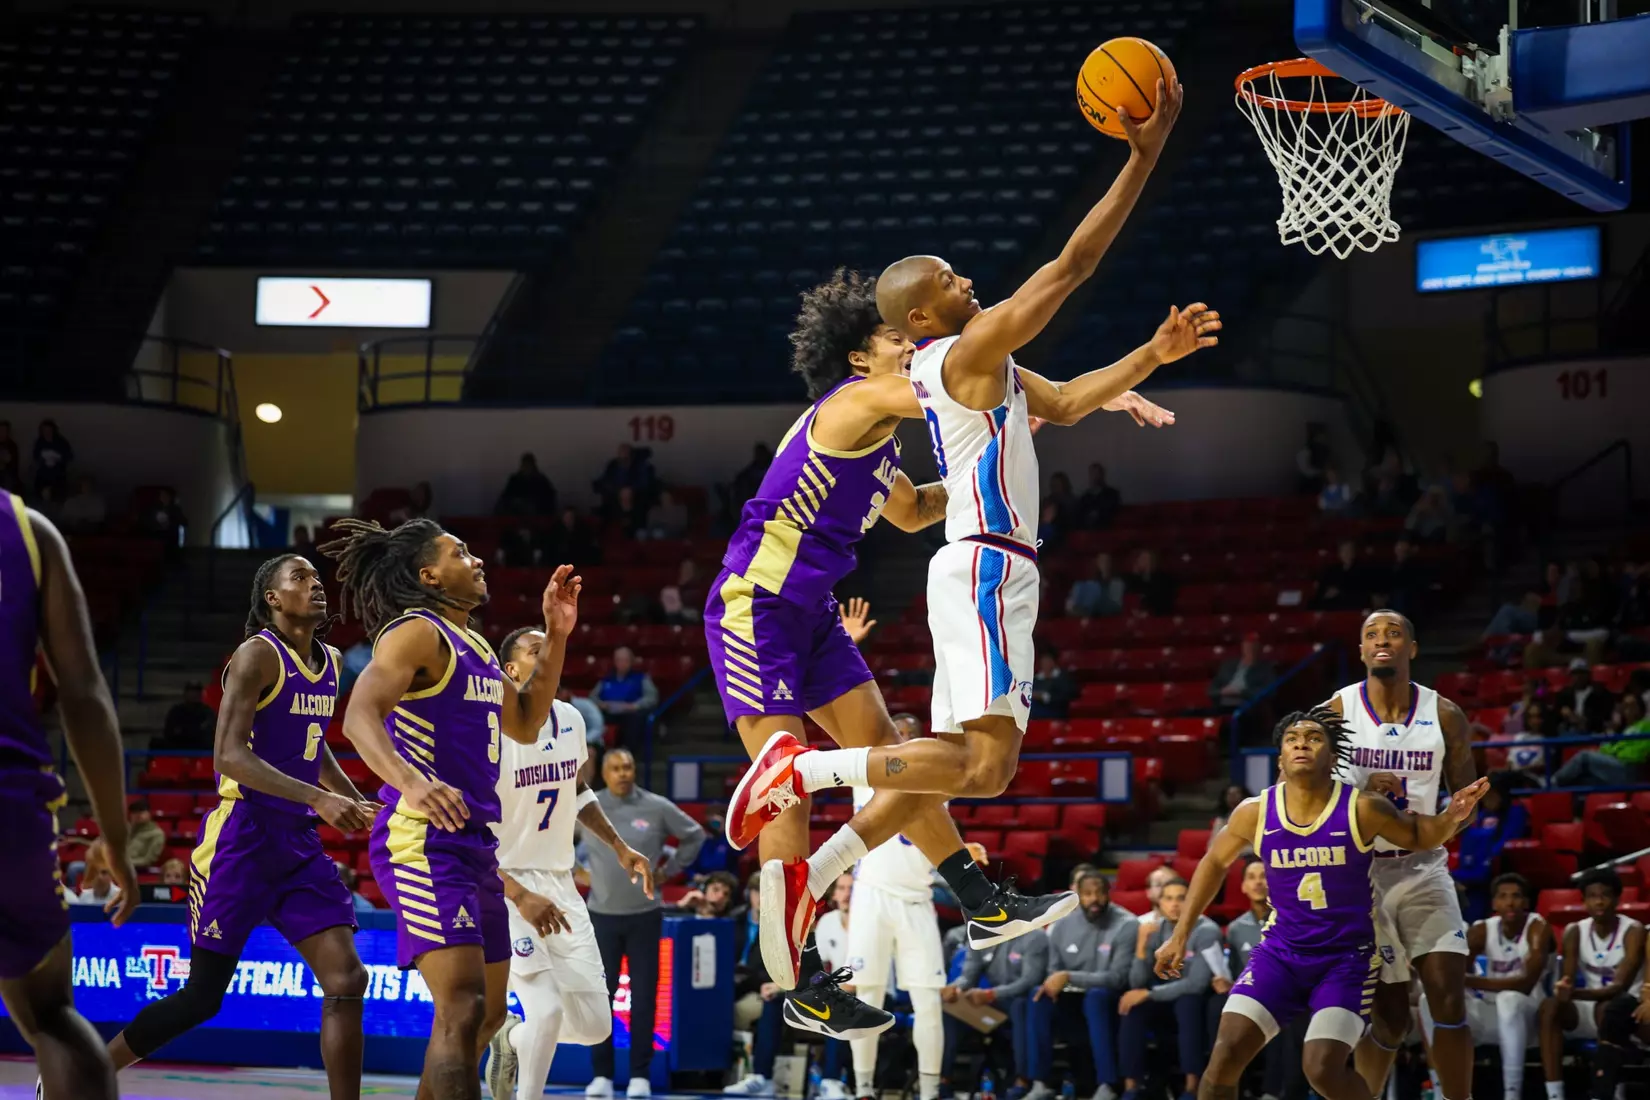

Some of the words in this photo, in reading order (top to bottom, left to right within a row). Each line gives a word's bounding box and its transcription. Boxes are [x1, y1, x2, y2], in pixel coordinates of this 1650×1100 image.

[1556, 368, 1607, 400] 101
[628, 415, 674, 442] 119
[463, 674, 504, 706] ALCOR
[487, 711, 500, 764] 3
[514, 762, 561, 788] LOUISIANA
[1406, 750, 1434, 770] TECH
[536, 788, 560, 832] 7
[1270, 846, 1346, 868] ALCORN
[1296, 872, 1328, 910] 4
[72, 957, 121, 988] IANA
[226, 960, 307, 996] FFICIAL
